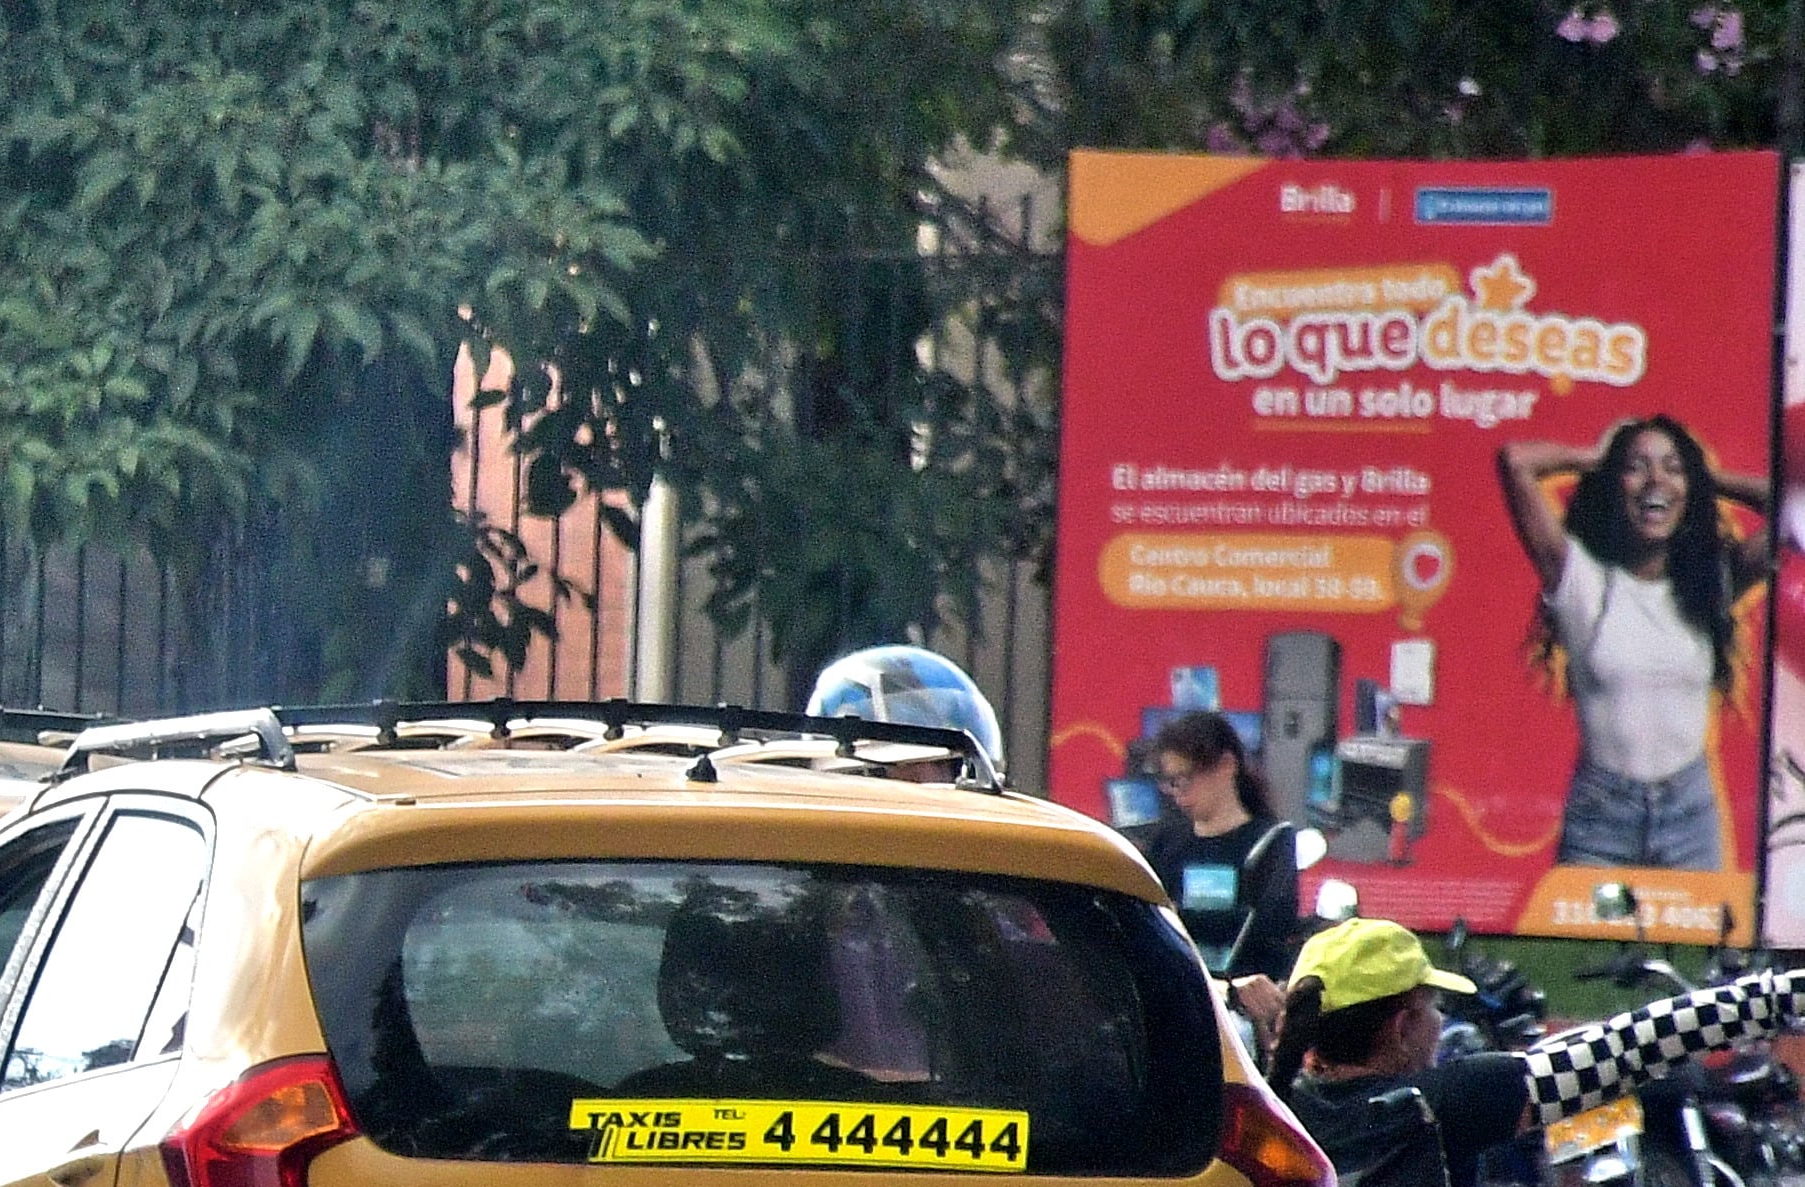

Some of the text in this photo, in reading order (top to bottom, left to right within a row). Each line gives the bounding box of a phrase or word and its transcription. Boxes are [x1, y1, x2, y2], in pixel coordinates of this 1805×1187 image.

[1281, 184, 1355, 212] Brilla
[1213, 300, 1641, 380] lo que deseas
[1252, 382, 1537, 428] en un solo lugar
[587, 1108, 746, 1129] TAXIS TEL:
[763, 1111, 1022, 1162] 4 444444
[626, 1130, 746, 1151] LIBRES
